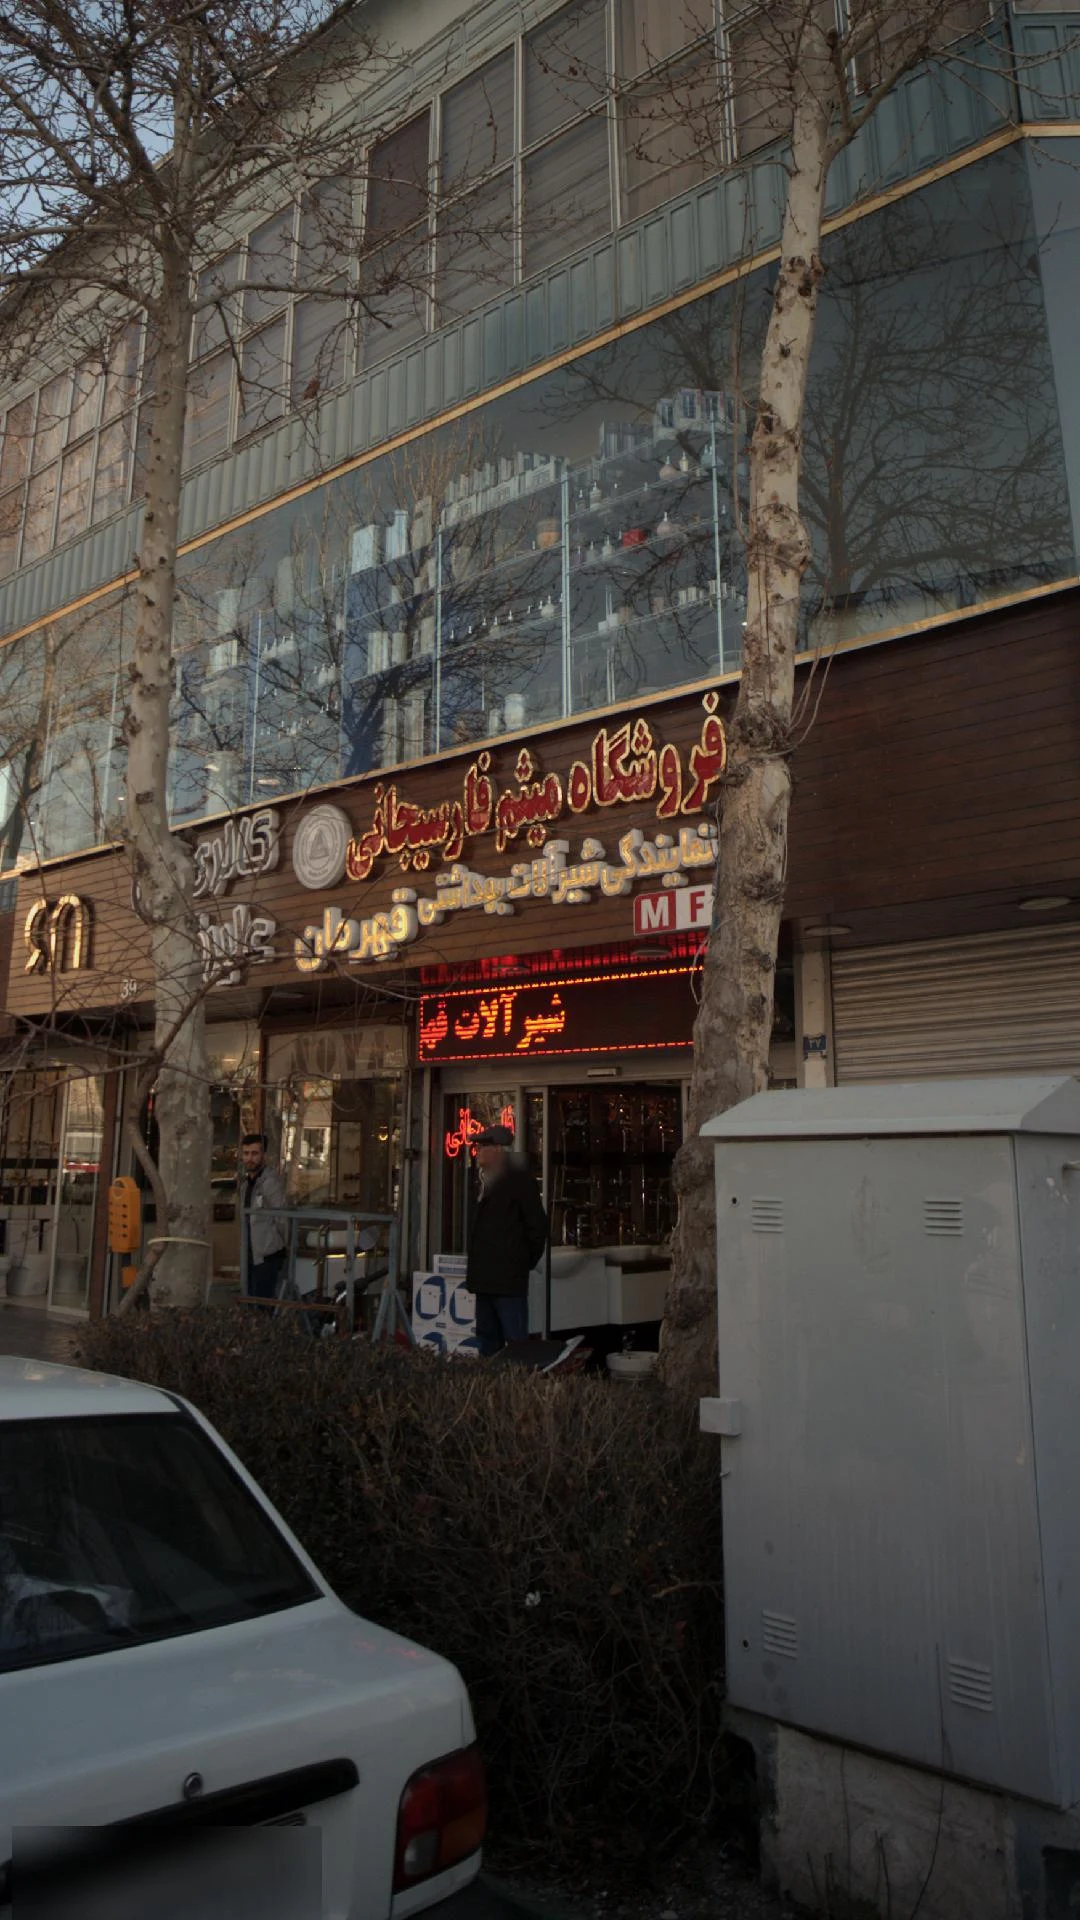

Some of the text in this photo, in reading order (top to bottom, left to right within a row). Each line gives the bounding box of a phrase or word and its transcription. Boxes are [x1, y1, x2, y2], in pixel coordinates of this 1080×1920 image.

[346, 692, 726, 880] فروشگاه میثم فارسیجانی
[295, 888, 418, 972] قهرمان
